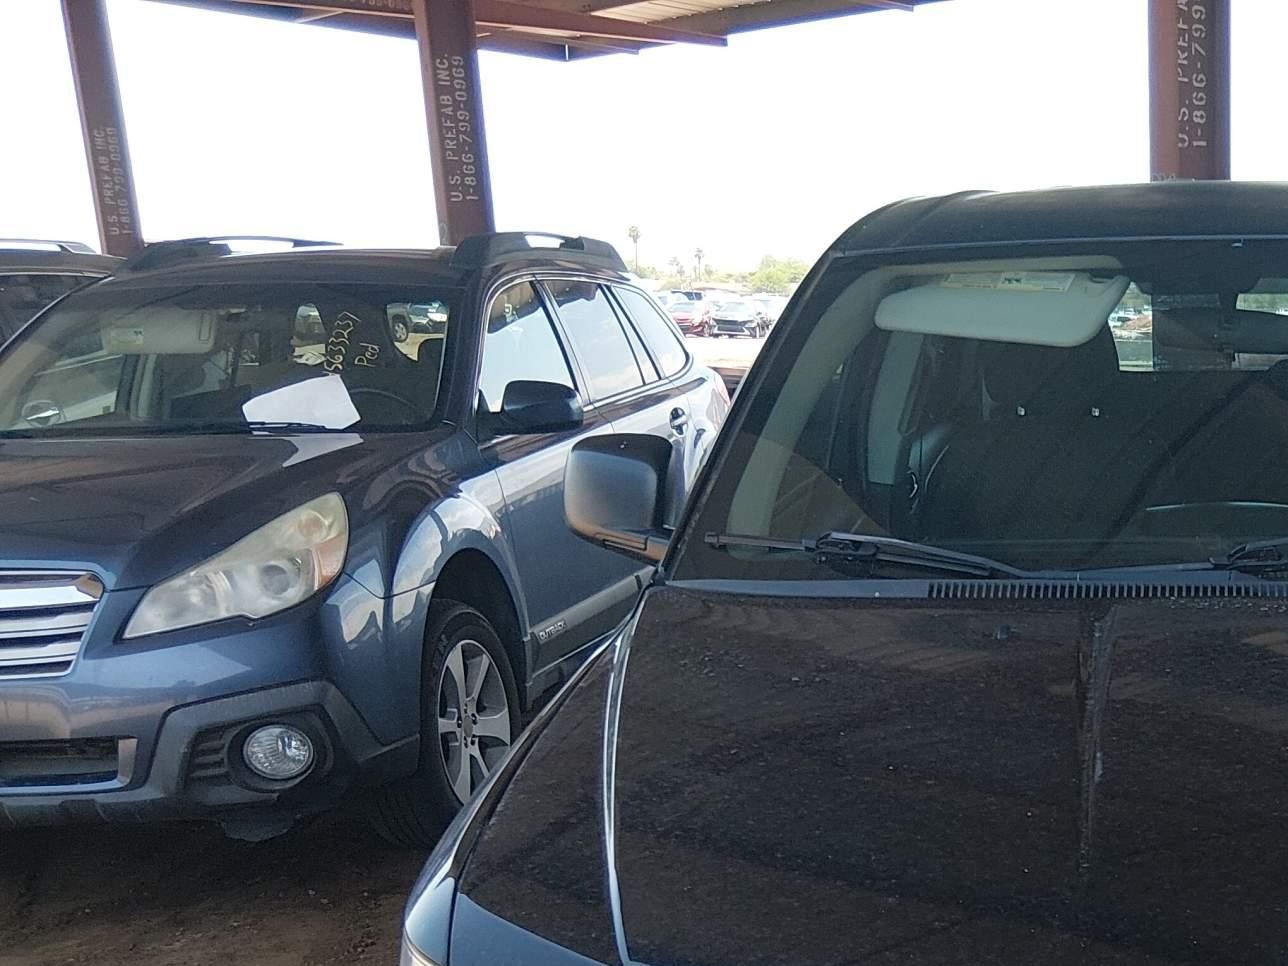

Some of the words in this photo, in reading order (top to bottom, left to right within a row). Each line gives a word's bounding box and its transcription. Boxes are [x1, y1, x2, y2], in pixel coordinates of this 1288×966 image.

[435, 53, 451, 85] INC.
[439, 94, 459, 160] PREFAB
[97, 155, 117, 206] PREFAB
[448, 170, 464, 202] U.S.
